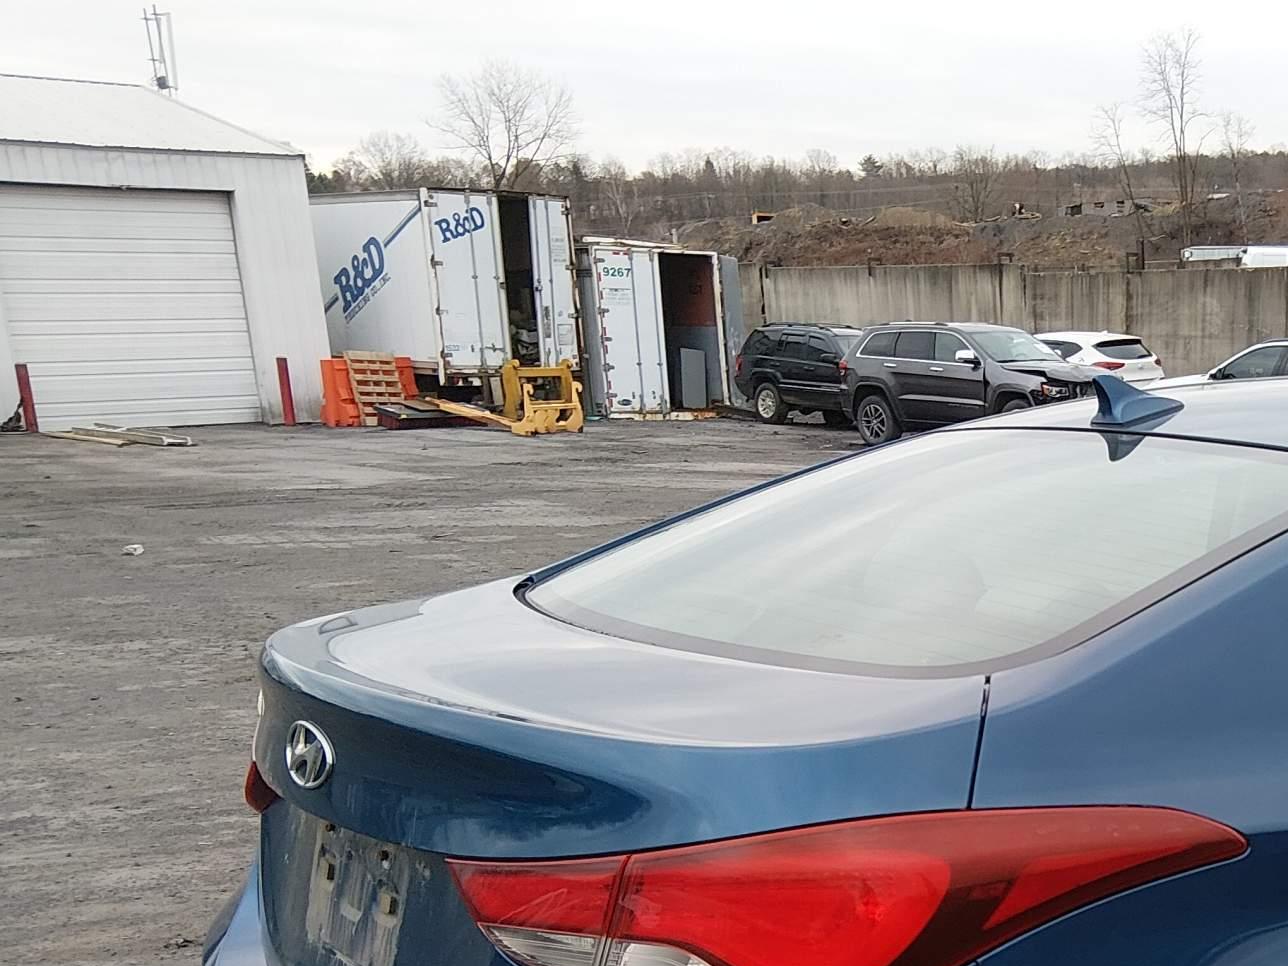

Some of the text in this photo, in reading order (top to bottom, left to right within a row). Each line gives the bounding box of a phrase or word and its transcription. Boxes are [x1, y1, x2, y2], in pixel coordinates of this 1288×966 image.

[434, 206, 485, 244] R&D
[333, 236, 385, 314] R&D
[602, 266, 632, 278] 9267
